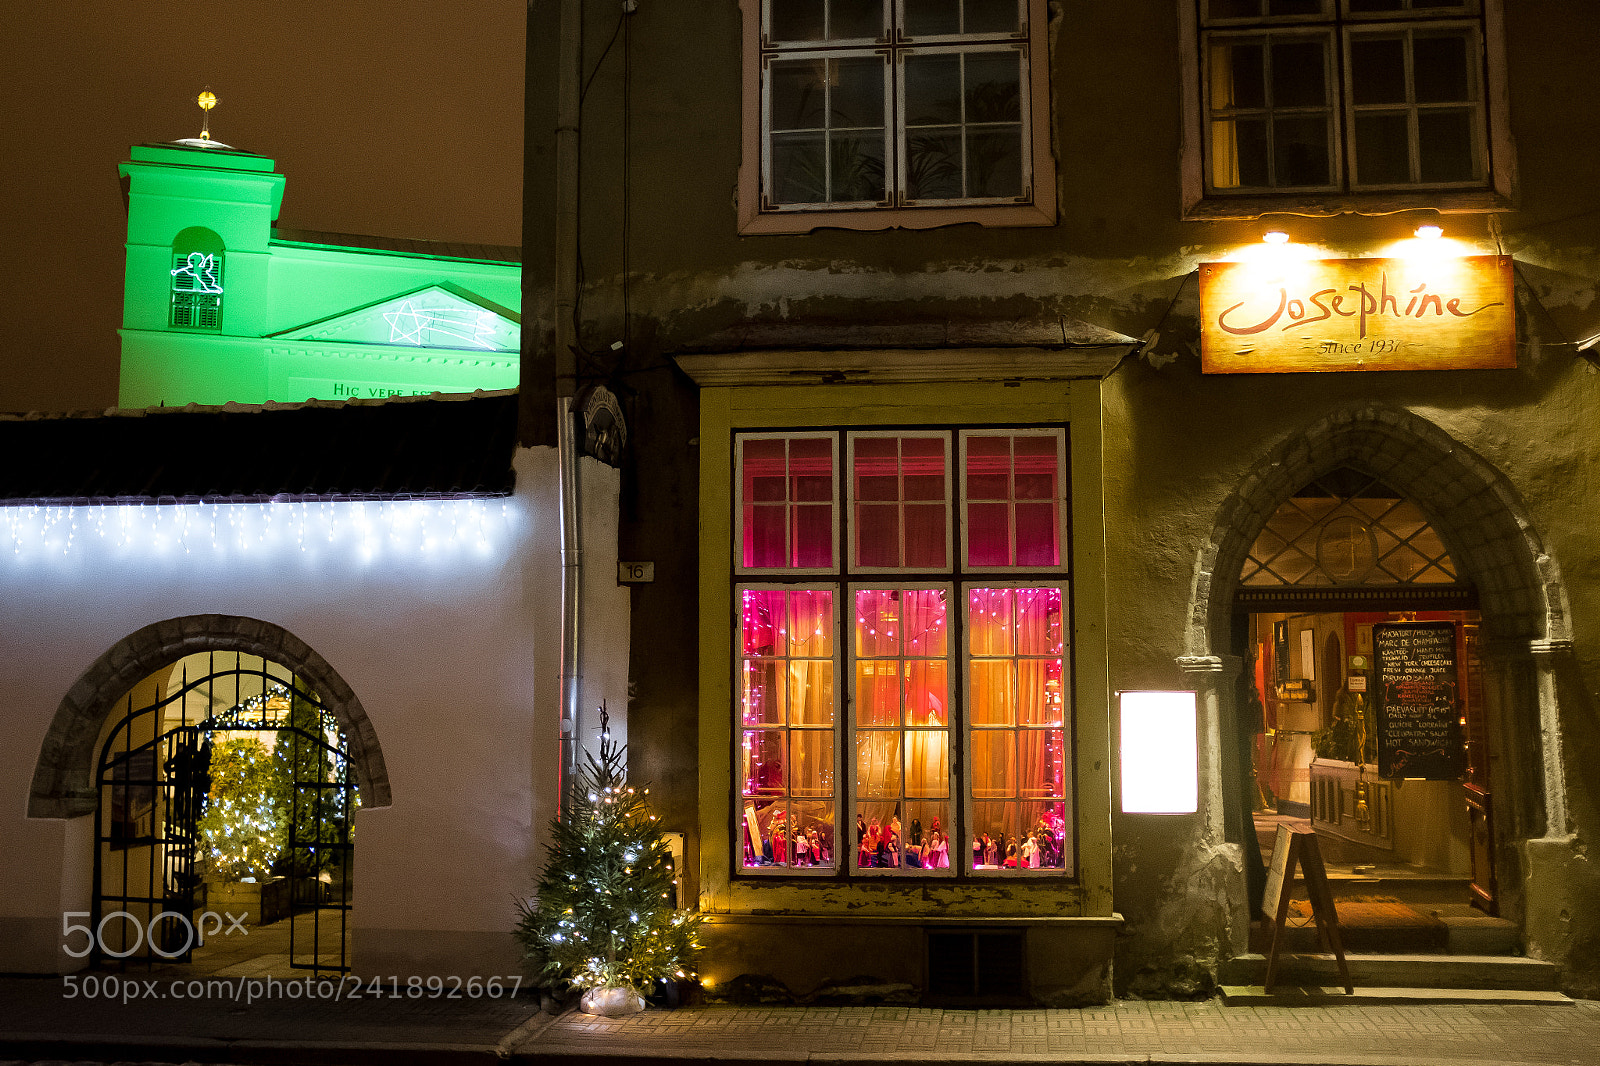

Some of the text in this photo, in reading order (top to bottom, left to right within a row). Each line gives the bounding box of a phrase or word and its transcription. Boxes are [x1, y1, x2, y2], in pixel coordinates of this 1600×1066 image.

[1219, 271, 1504, 340] Josephine
[1317, 338, 1402, 354] since 1937
[626, 565, 644, 579] 16
[1385, 739, 1402, 748] HOT
